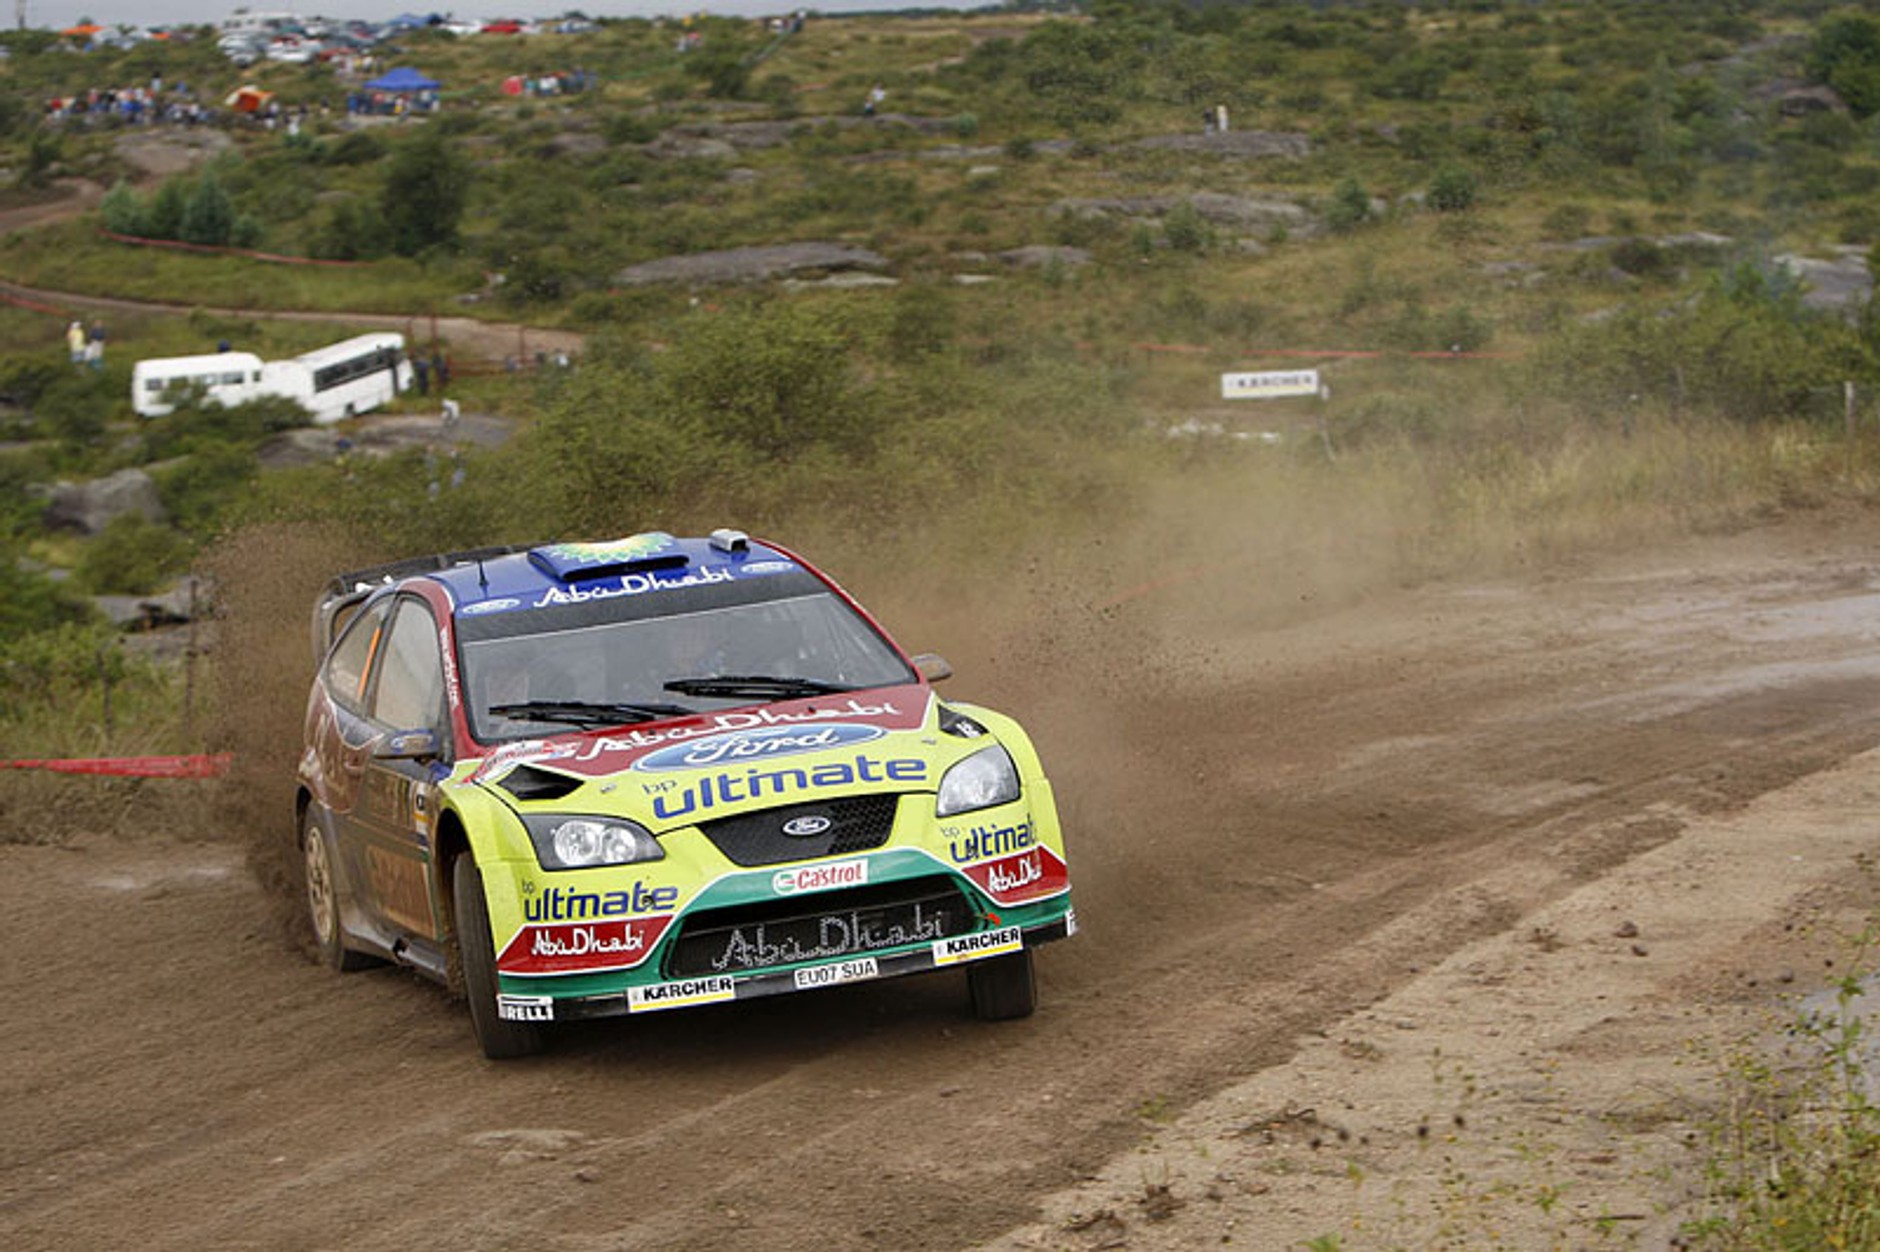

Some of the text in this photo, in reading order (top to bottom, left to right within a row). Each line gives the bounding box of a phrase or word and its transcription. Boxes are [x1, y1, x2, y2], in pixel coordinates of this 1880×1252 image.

[684, 728, 840, 763] Ford
[653, 755, 927, 819] ultimate
[798, 863, 862, 890] Castrol
[525, 880, 678, 922] ultimate
[798, 963, 876, 986] EU07 SUA
